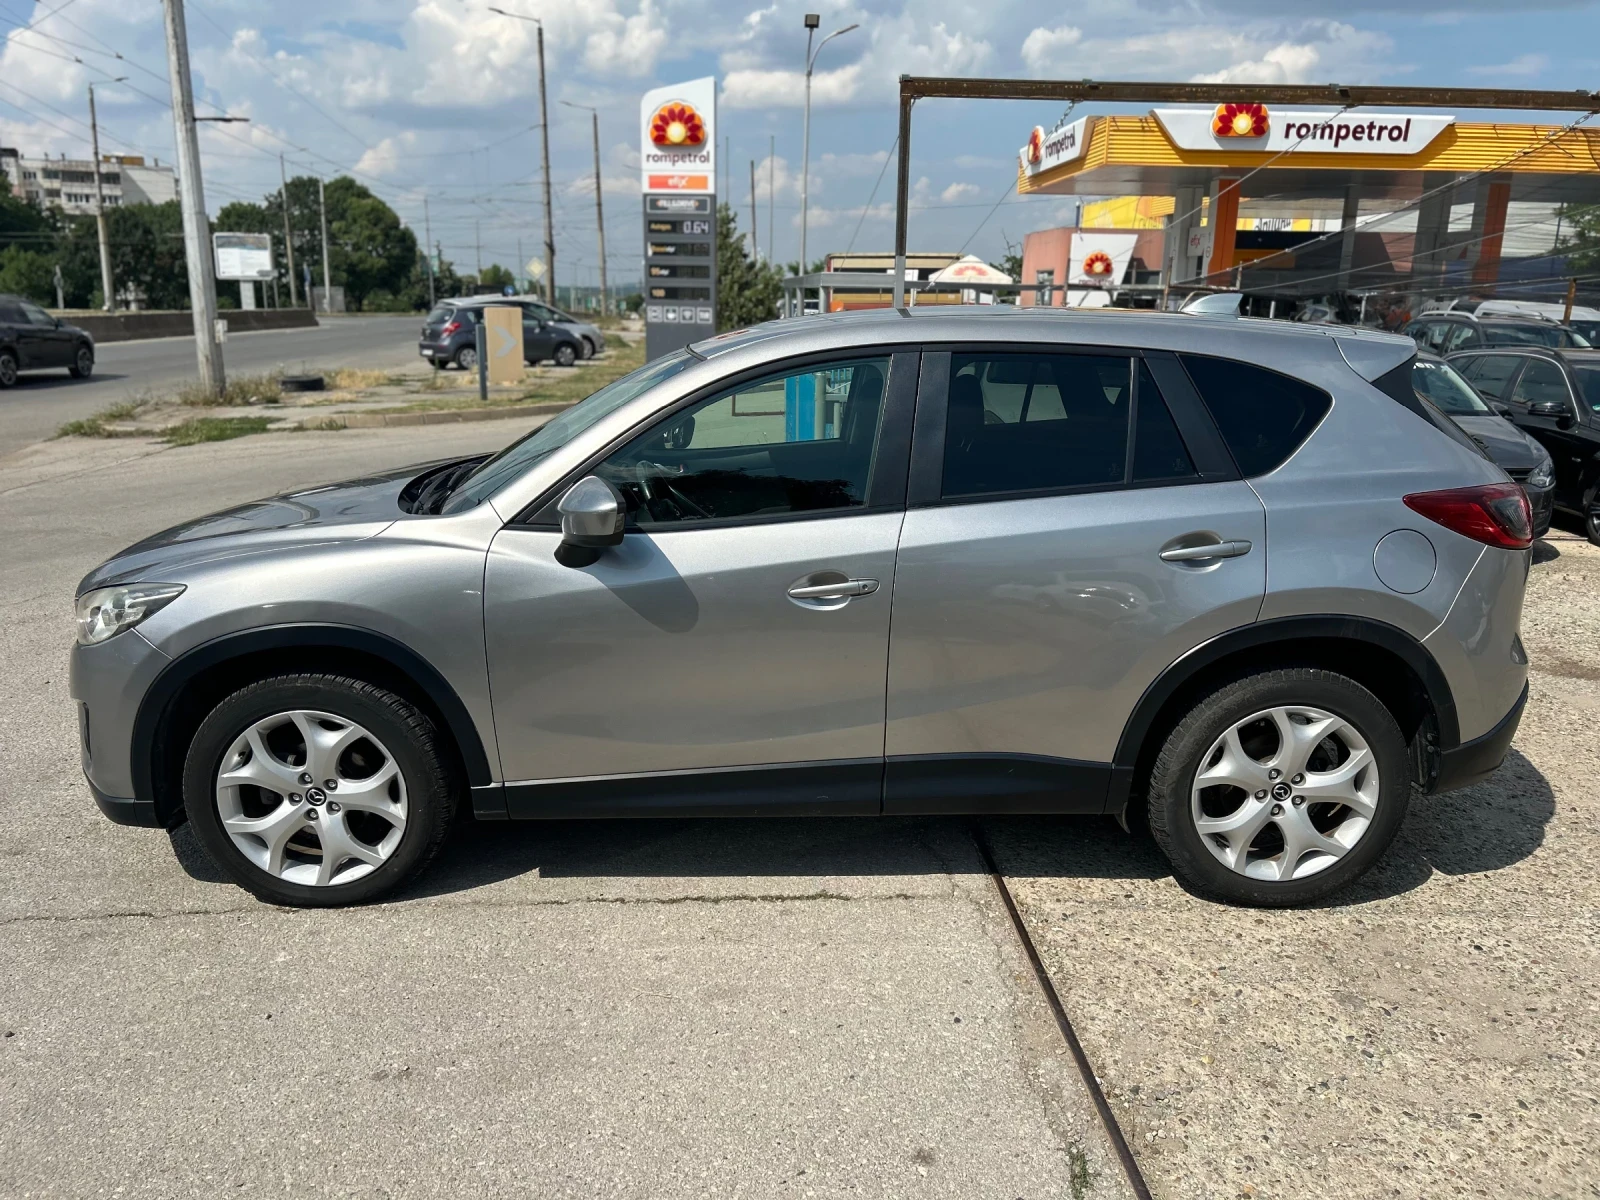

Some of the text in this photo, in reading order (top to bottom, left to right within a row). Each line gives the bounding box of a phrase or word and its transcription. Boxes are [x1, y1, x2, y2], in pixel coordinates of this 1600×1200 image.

[1045, 125, 1076, 160] rompetrol
[1284, 118, 1412, 148] rompetrol
[646, 151, 710, 166] rompetrol
[683, 221, 709, 235] 0.64
